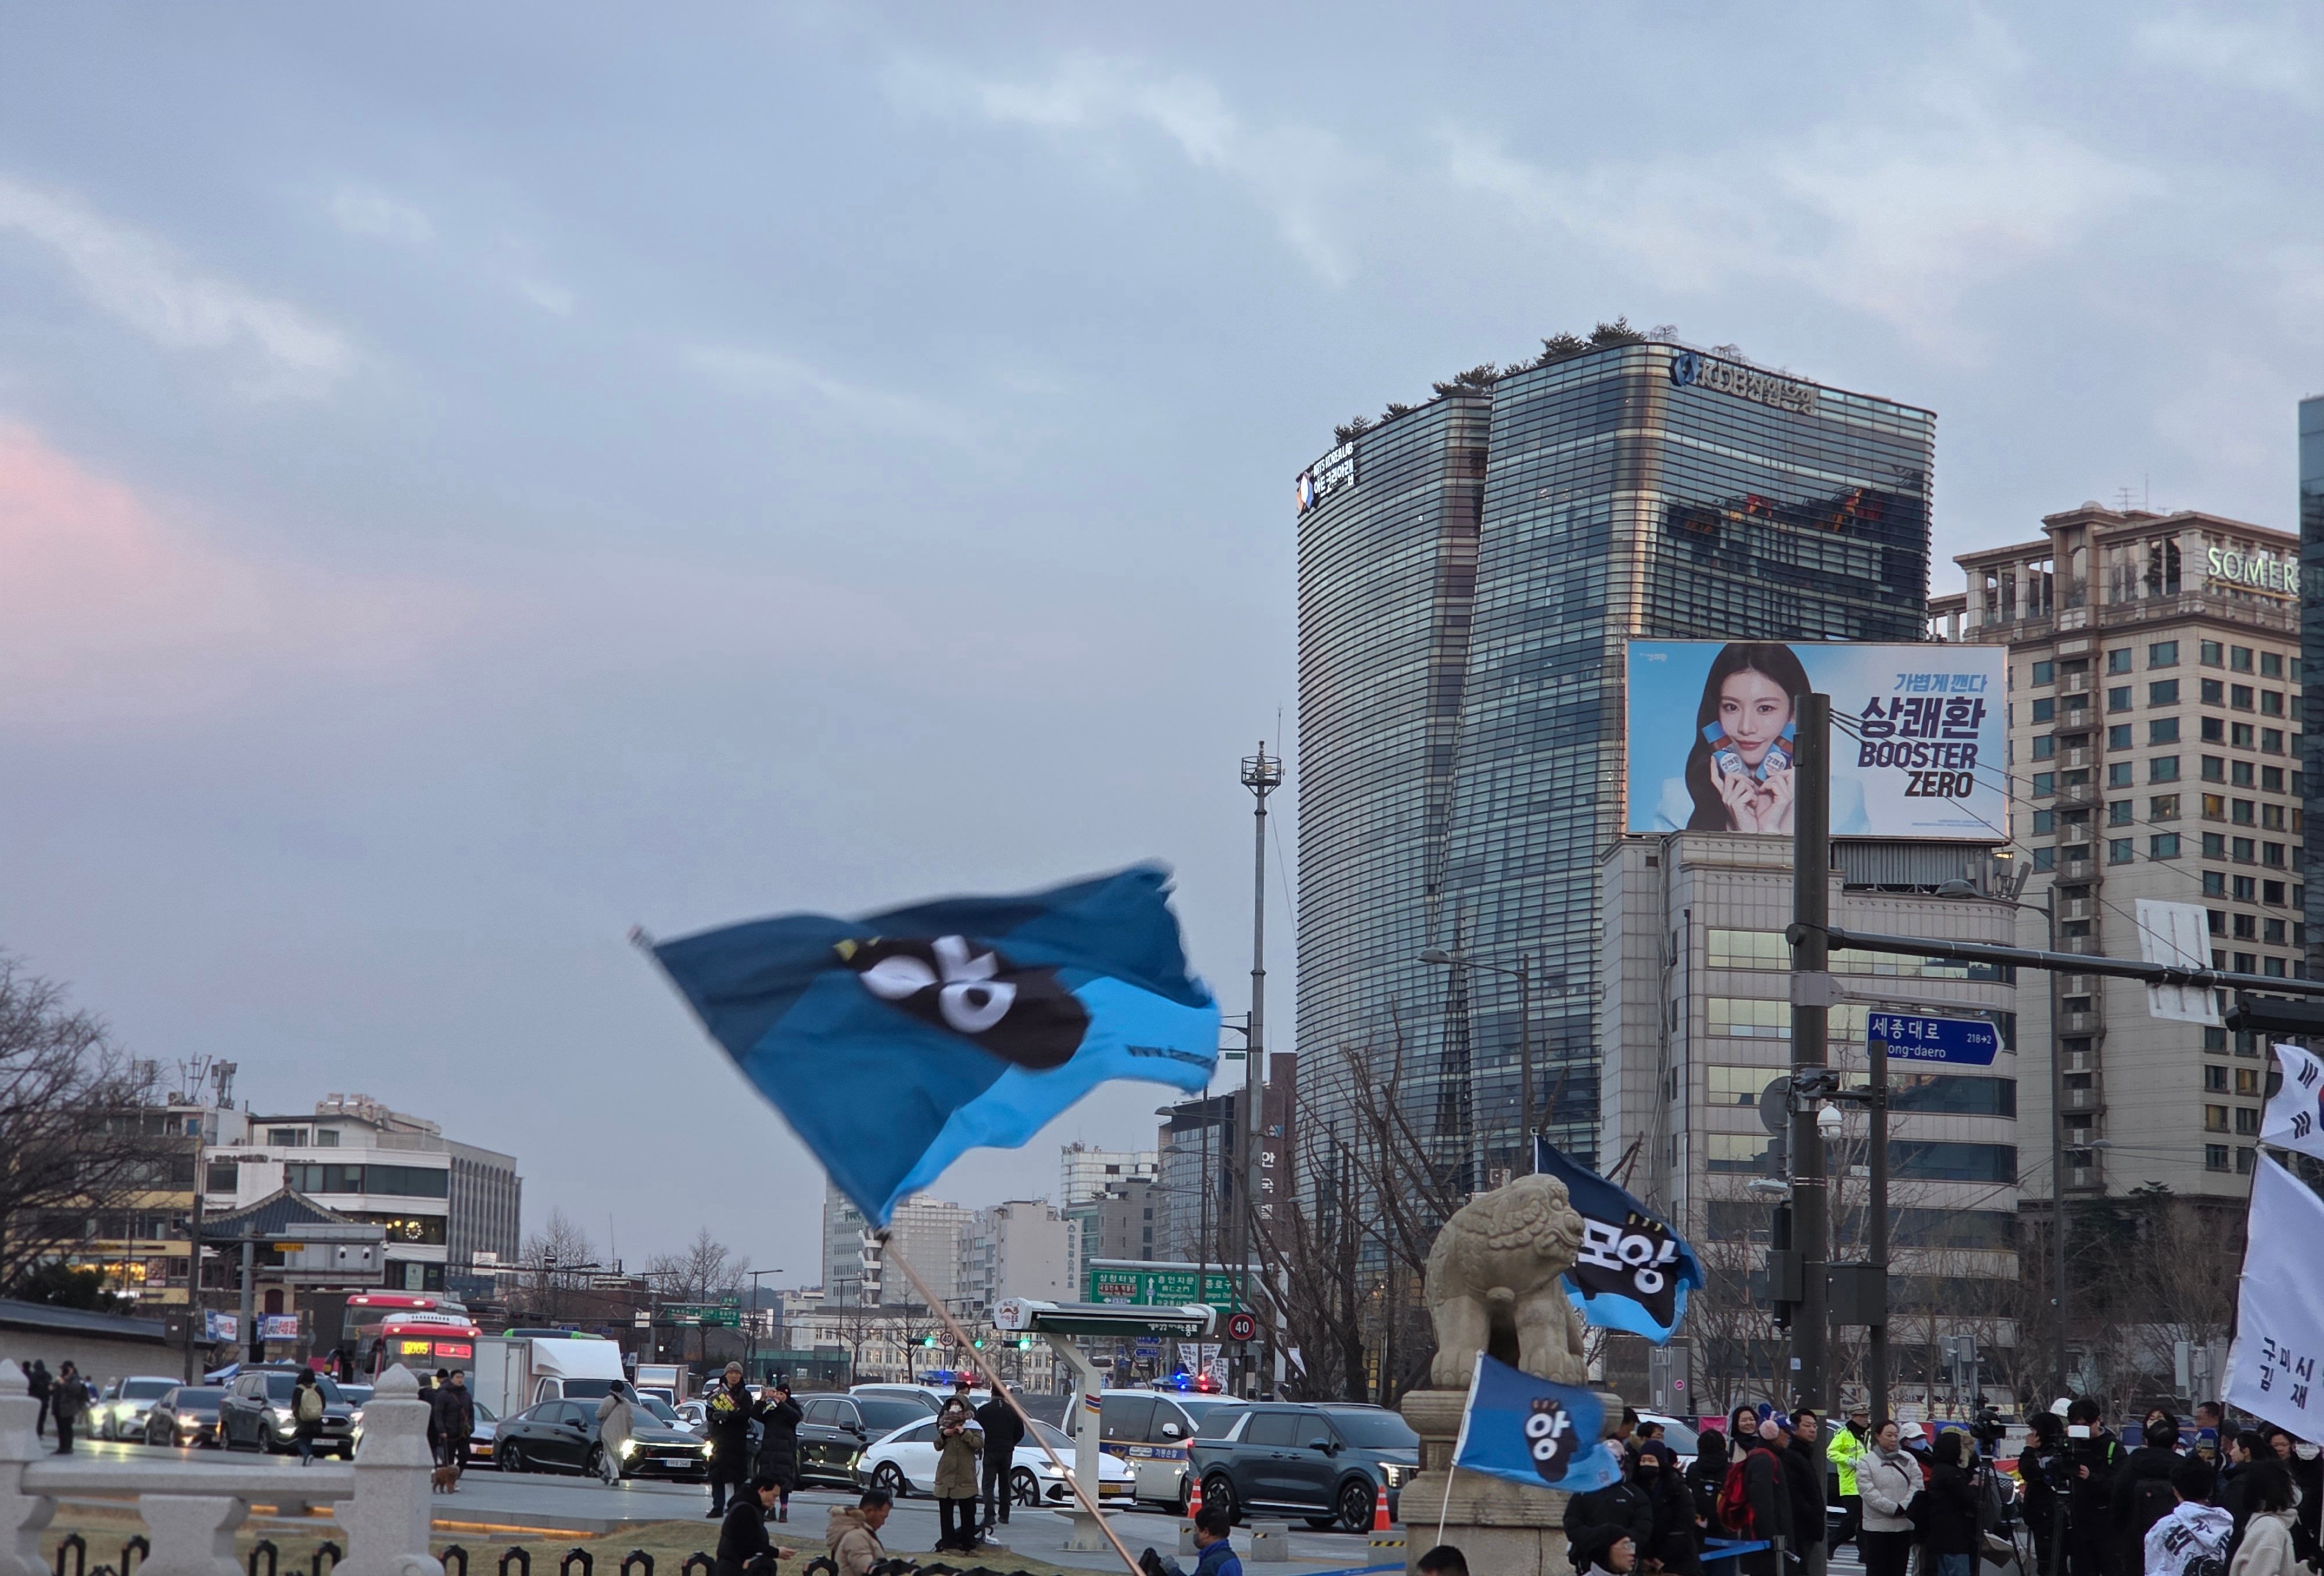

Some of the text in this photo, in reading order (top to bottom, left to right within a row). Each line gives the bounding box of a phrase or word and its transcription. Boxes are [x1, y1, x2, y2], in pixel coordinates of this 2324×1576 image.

[1698, 360, 1818, 416] KDB산업은행
[1325, 447, 1342, 468] KOREA
[1342, 441, 1354, 458] LAB
[1314, 458, 1354, 497] 아트코리아랩
[1893, 673, 1988, 693] 가볍게 깬다
[1859, 695, 1986, 739] 상쾌환
[1857, 741, 1979, 769] BOOSTER
[1904, 770, 1973, 798] ZERO
[1871, 1017, 1941, 1040] 세종대로
[1887, 1044, 1946, 1059] ong-daero
[1577, 1217, 1679, 1294] 모앙
[1157, 1275, 1195, 1285] 흥인지문
[943, 1334, 952, 1343] 40
[1235, 1321, 1249, 1334] 40
[2261, 1336, 2315, 1382] 구미시
